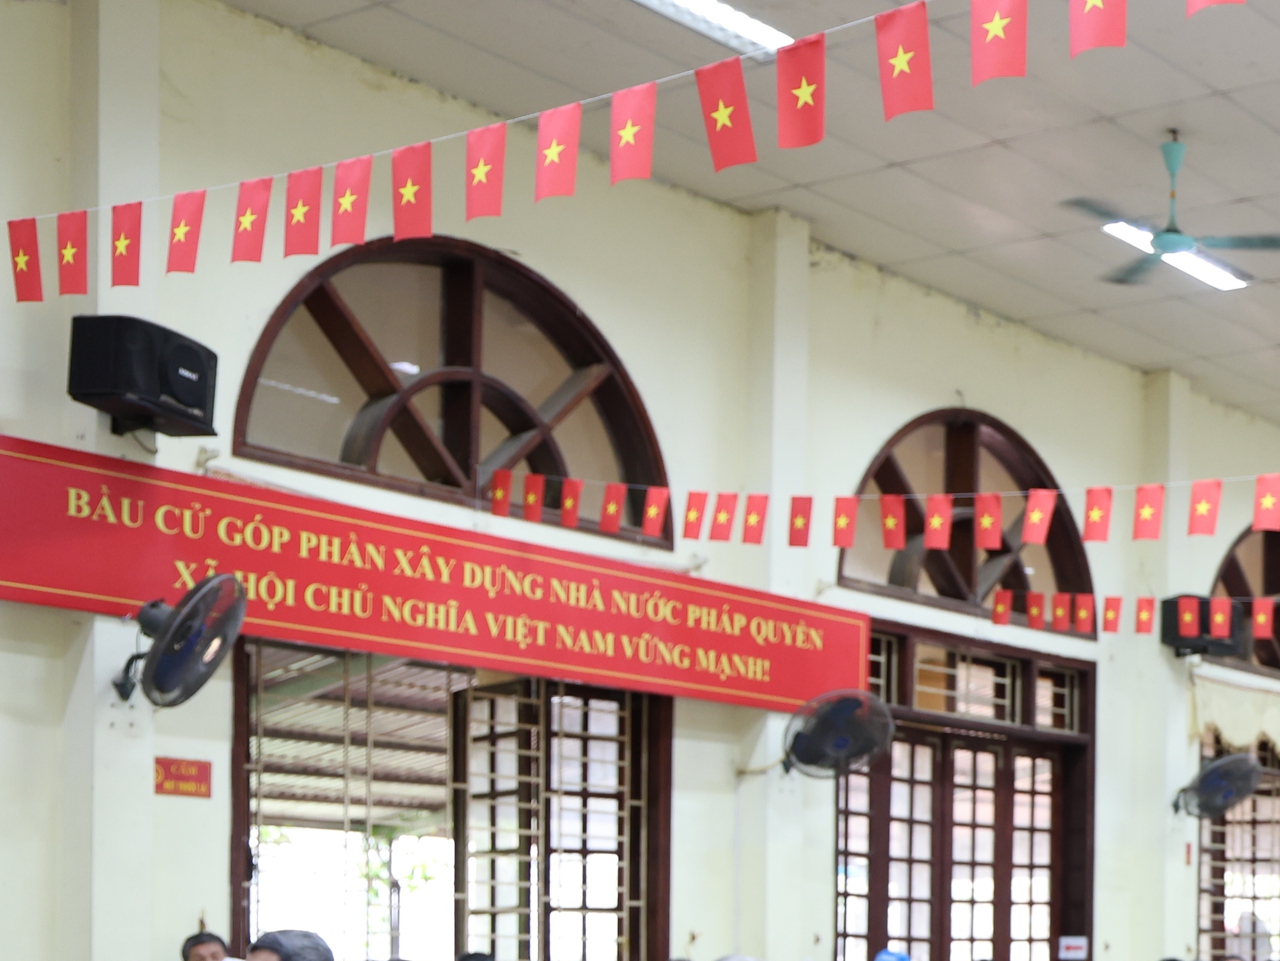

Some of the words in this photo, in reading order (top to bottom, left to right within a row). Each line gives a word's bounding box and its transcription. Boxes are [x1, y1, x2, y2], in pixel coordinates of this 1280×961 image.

[66, 484, 145, 528] BẦU
[154, 501, 212, 539] CỬ
[217, 513, 291, 553] GÓP
[299, 531, 386, 572] PHẦN
[393, 544, 457, 584] XÂY
[462, 561, 544, 600] DỰNG
[550, 577, 605, 612] NHÀ
[611, 589, 683, 626] NƯỚC
[686, 603, 748, 637] PHÁP
[750, 616, 824, 651] QUYỀN
[233, 570, 297, 611] HỘI
[304, 582, 374, 619] CHỦ
[381, 594, 479, 636] NGHĨA
[485, 611, 551, 650] VIỆT
[556, 624, 616, 658] NAM
[620, 632, 691, 669] VỮNG
[695, 647, 771, 683] MẠNH!
